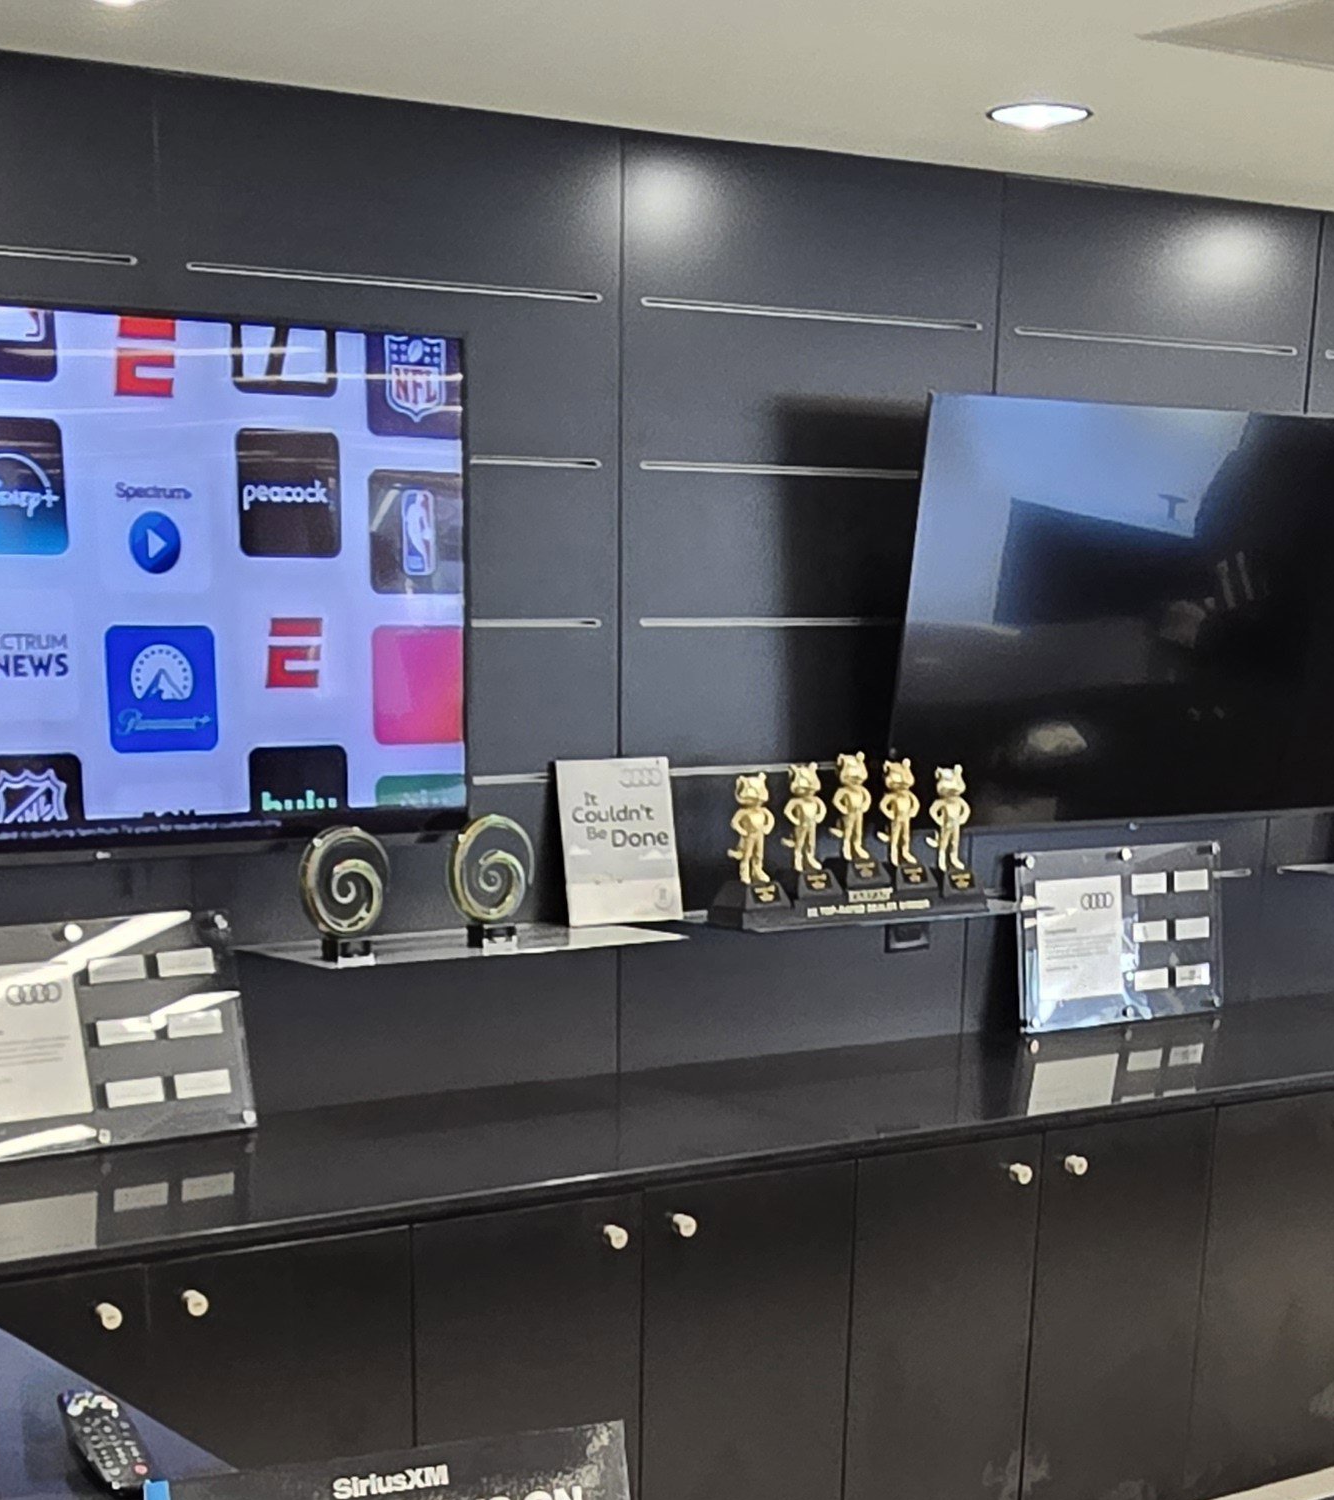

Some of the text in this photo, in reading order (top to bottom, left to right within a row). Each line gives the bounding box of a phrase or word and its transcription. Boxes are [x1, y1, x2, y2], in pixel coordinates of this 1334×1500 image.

[394, 367, 438, 405] NFL
[115, 481, 191, 502] Spectrum
[241, 481, 328, 510] peacock
[584, 791, 598, 807] It
[571, 804, 655, 825] Couldn't
[586, 826, 670, 849] Be Done
[332, 1463, 450, 1500] SiriusXM
